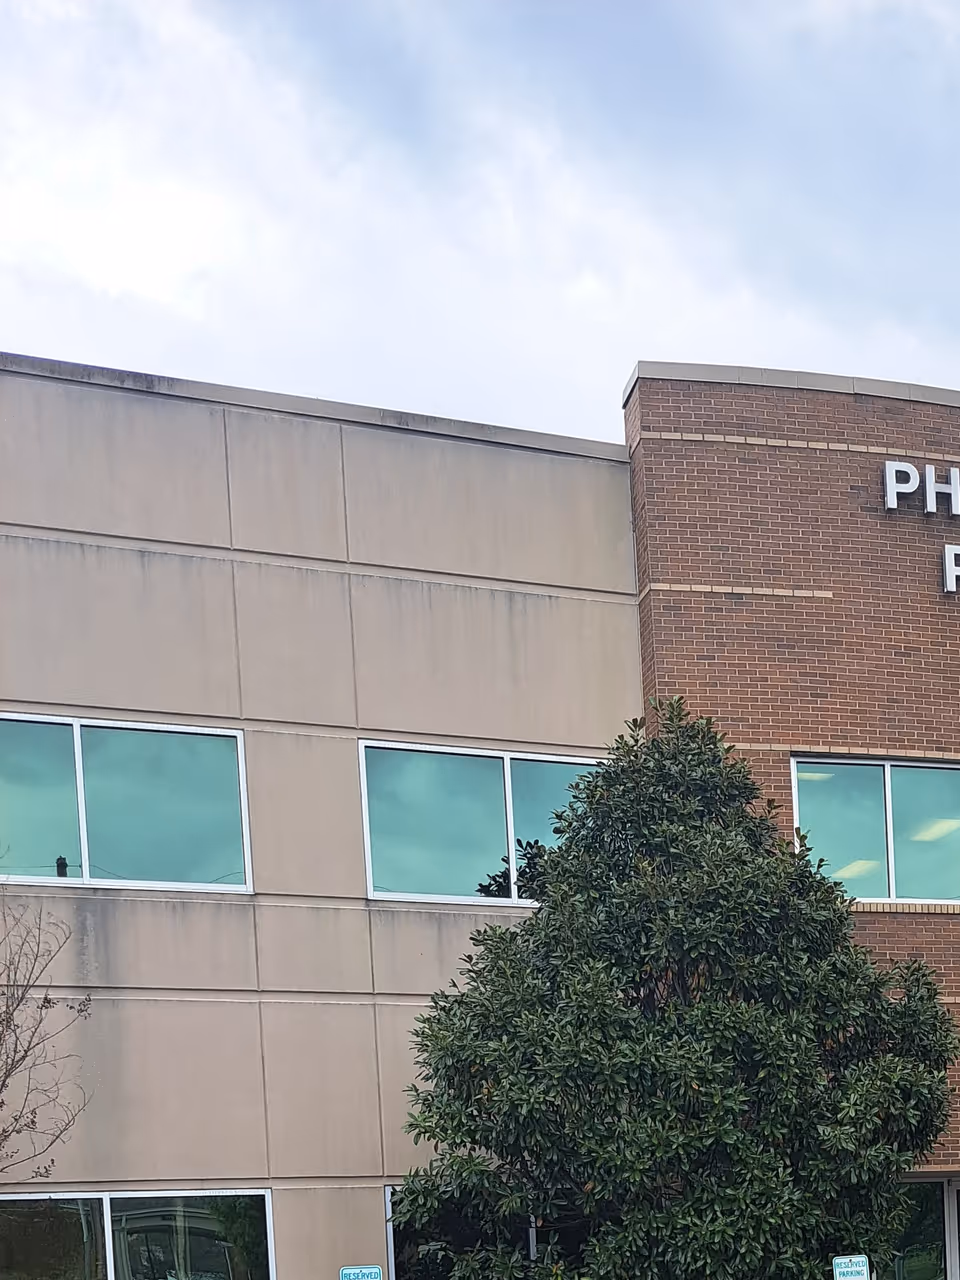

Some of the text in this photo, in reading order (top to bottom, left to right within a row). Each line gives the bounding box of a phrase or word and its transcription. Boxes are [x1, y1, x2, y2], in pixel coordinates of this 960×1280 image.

[835, 1260, 866, 1268] RESERVED
[344, 1272, 379, 1280] RESERVED
[838, 1269, 864, 1277] PARKING
